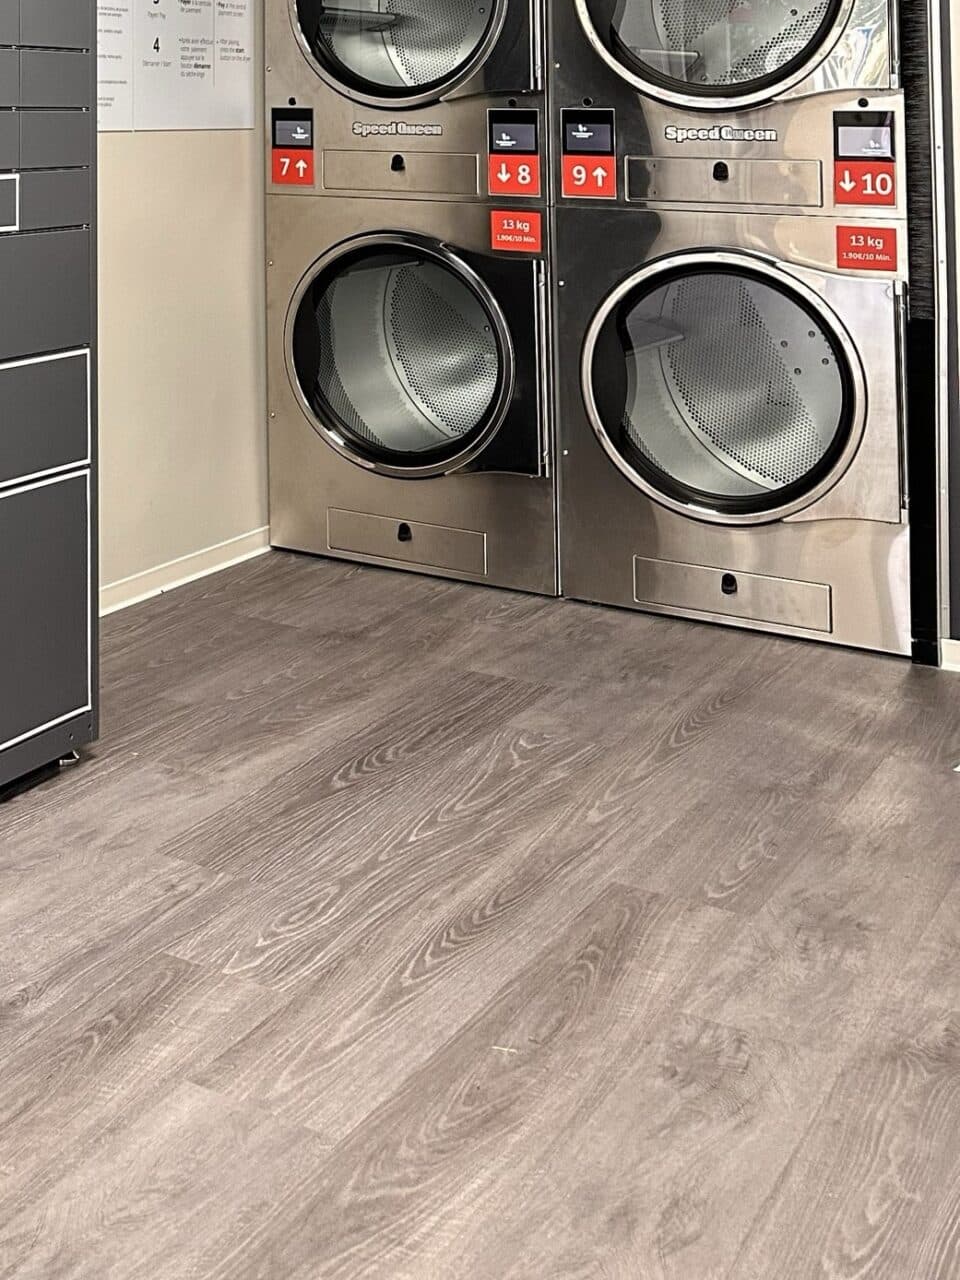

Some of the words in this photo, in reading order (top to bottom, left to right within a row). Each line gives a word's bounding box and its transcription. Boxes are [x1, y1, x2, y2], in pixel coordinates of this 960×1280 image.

[153, 37, 161, 53] 4
[280, 158, 290, 176] 7
[517, 165, 531, 184] 8
[572, 165, 587, 186] 9
[861, 173, 893, 195] 10
[502, 219, 514, 230] 13
[516, 219, 530, 233] kg
[850, 235, 865, 247] 13
[867, 235, 884, 250] kg
